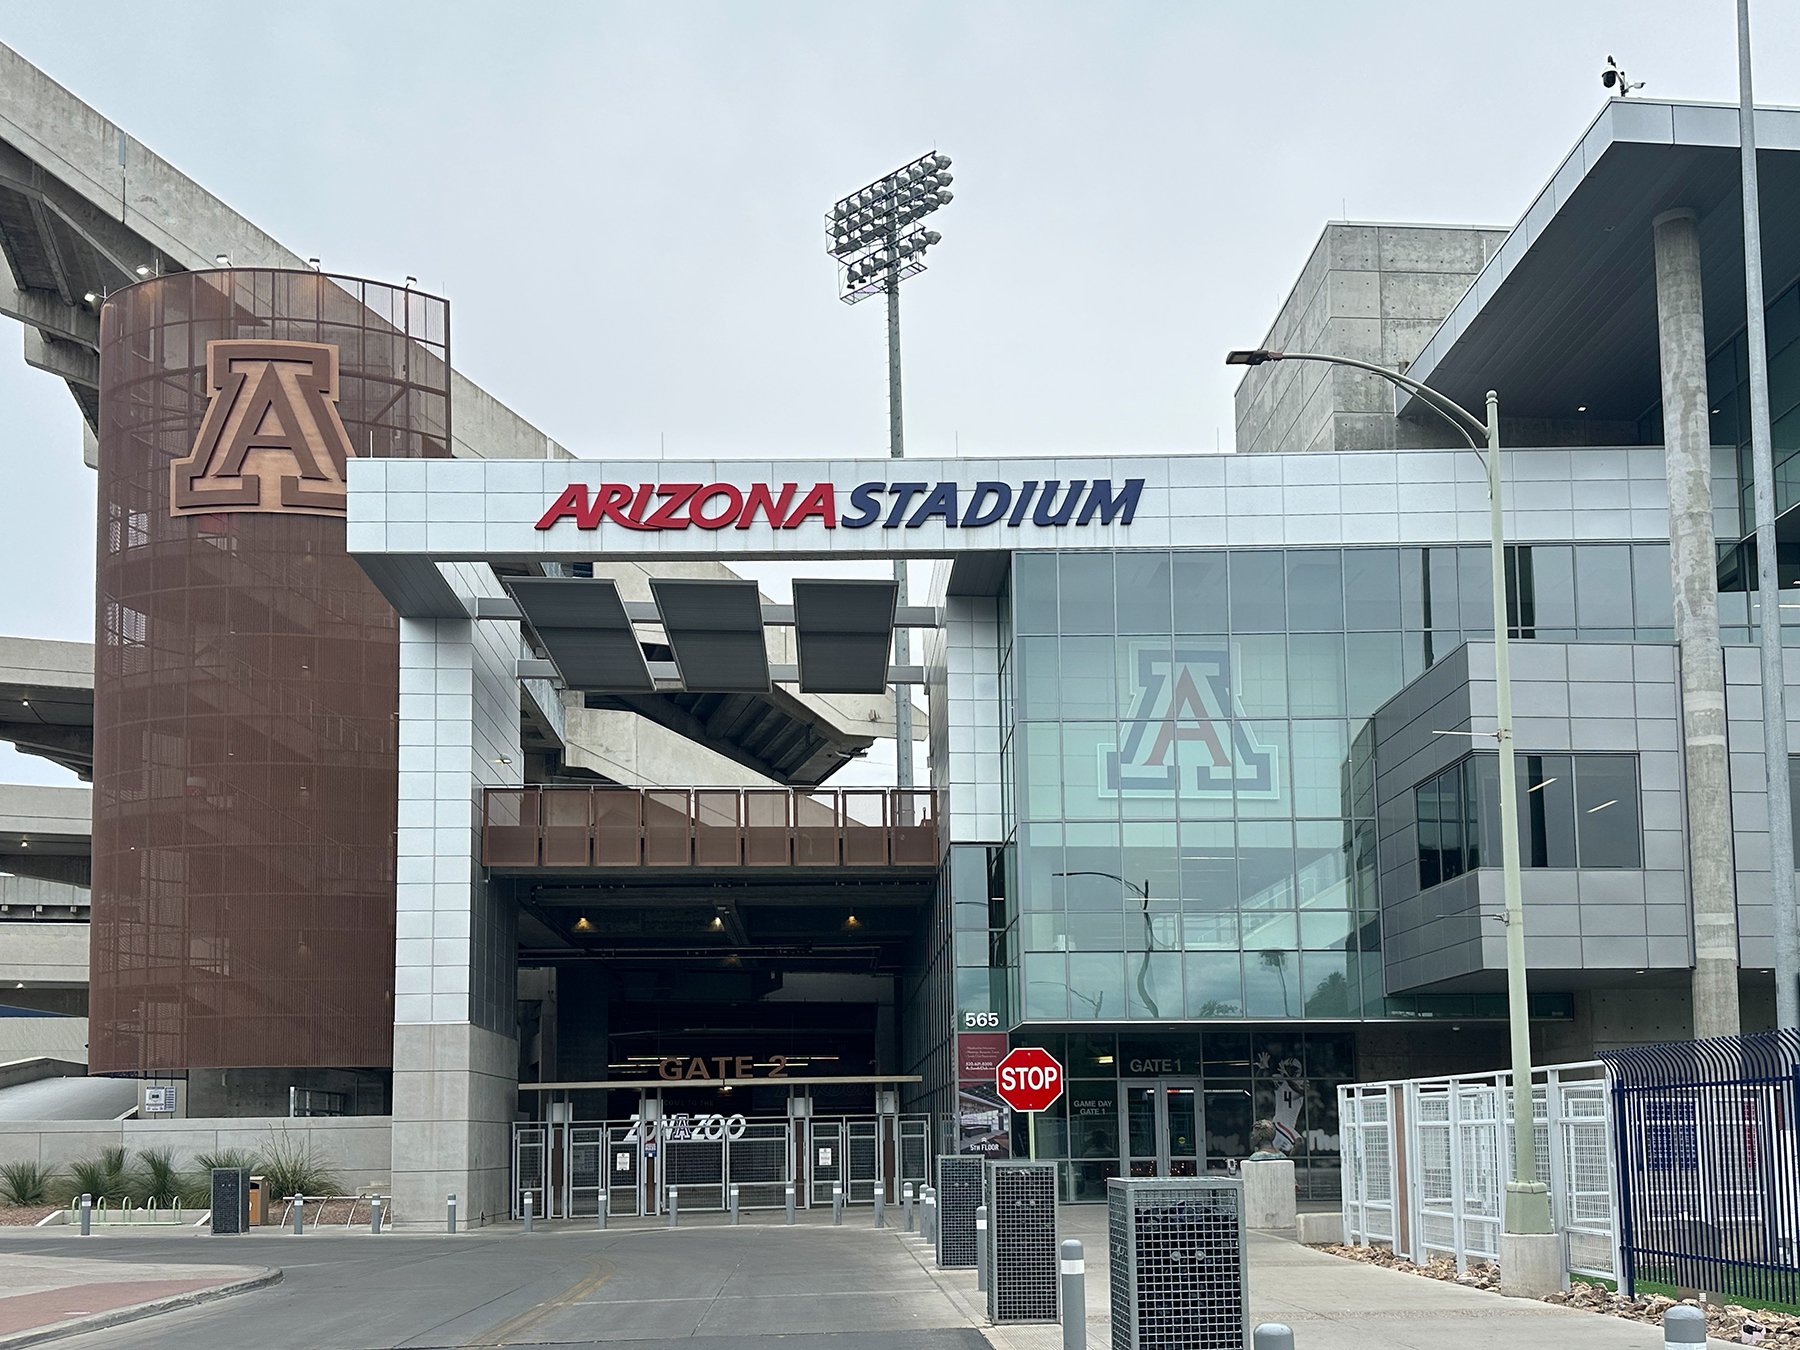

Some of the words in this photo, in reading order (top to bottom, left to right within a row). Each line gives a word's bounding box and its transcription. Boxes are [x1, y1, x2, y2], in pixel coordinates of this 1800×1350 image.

[534, 483, 836, 531] ARIZONA
[840, 478, 1147, 528] STADIUM
[1097, 641, 1280, 800] A
[965, 1012, 999, 1027] 565
[658, 1056, 754, 1080] GATE
[768, 1055, 788, 1078] 2
[1130, 1059, 1172, 1073] GATE
[1175, 1059, 1181, 1072] 1
[1001, 1066, 1058, 1091] STOP
[1283, 1090, 1292, 1109] 4
[981, 1143, 1000, 1151] FLOOR
